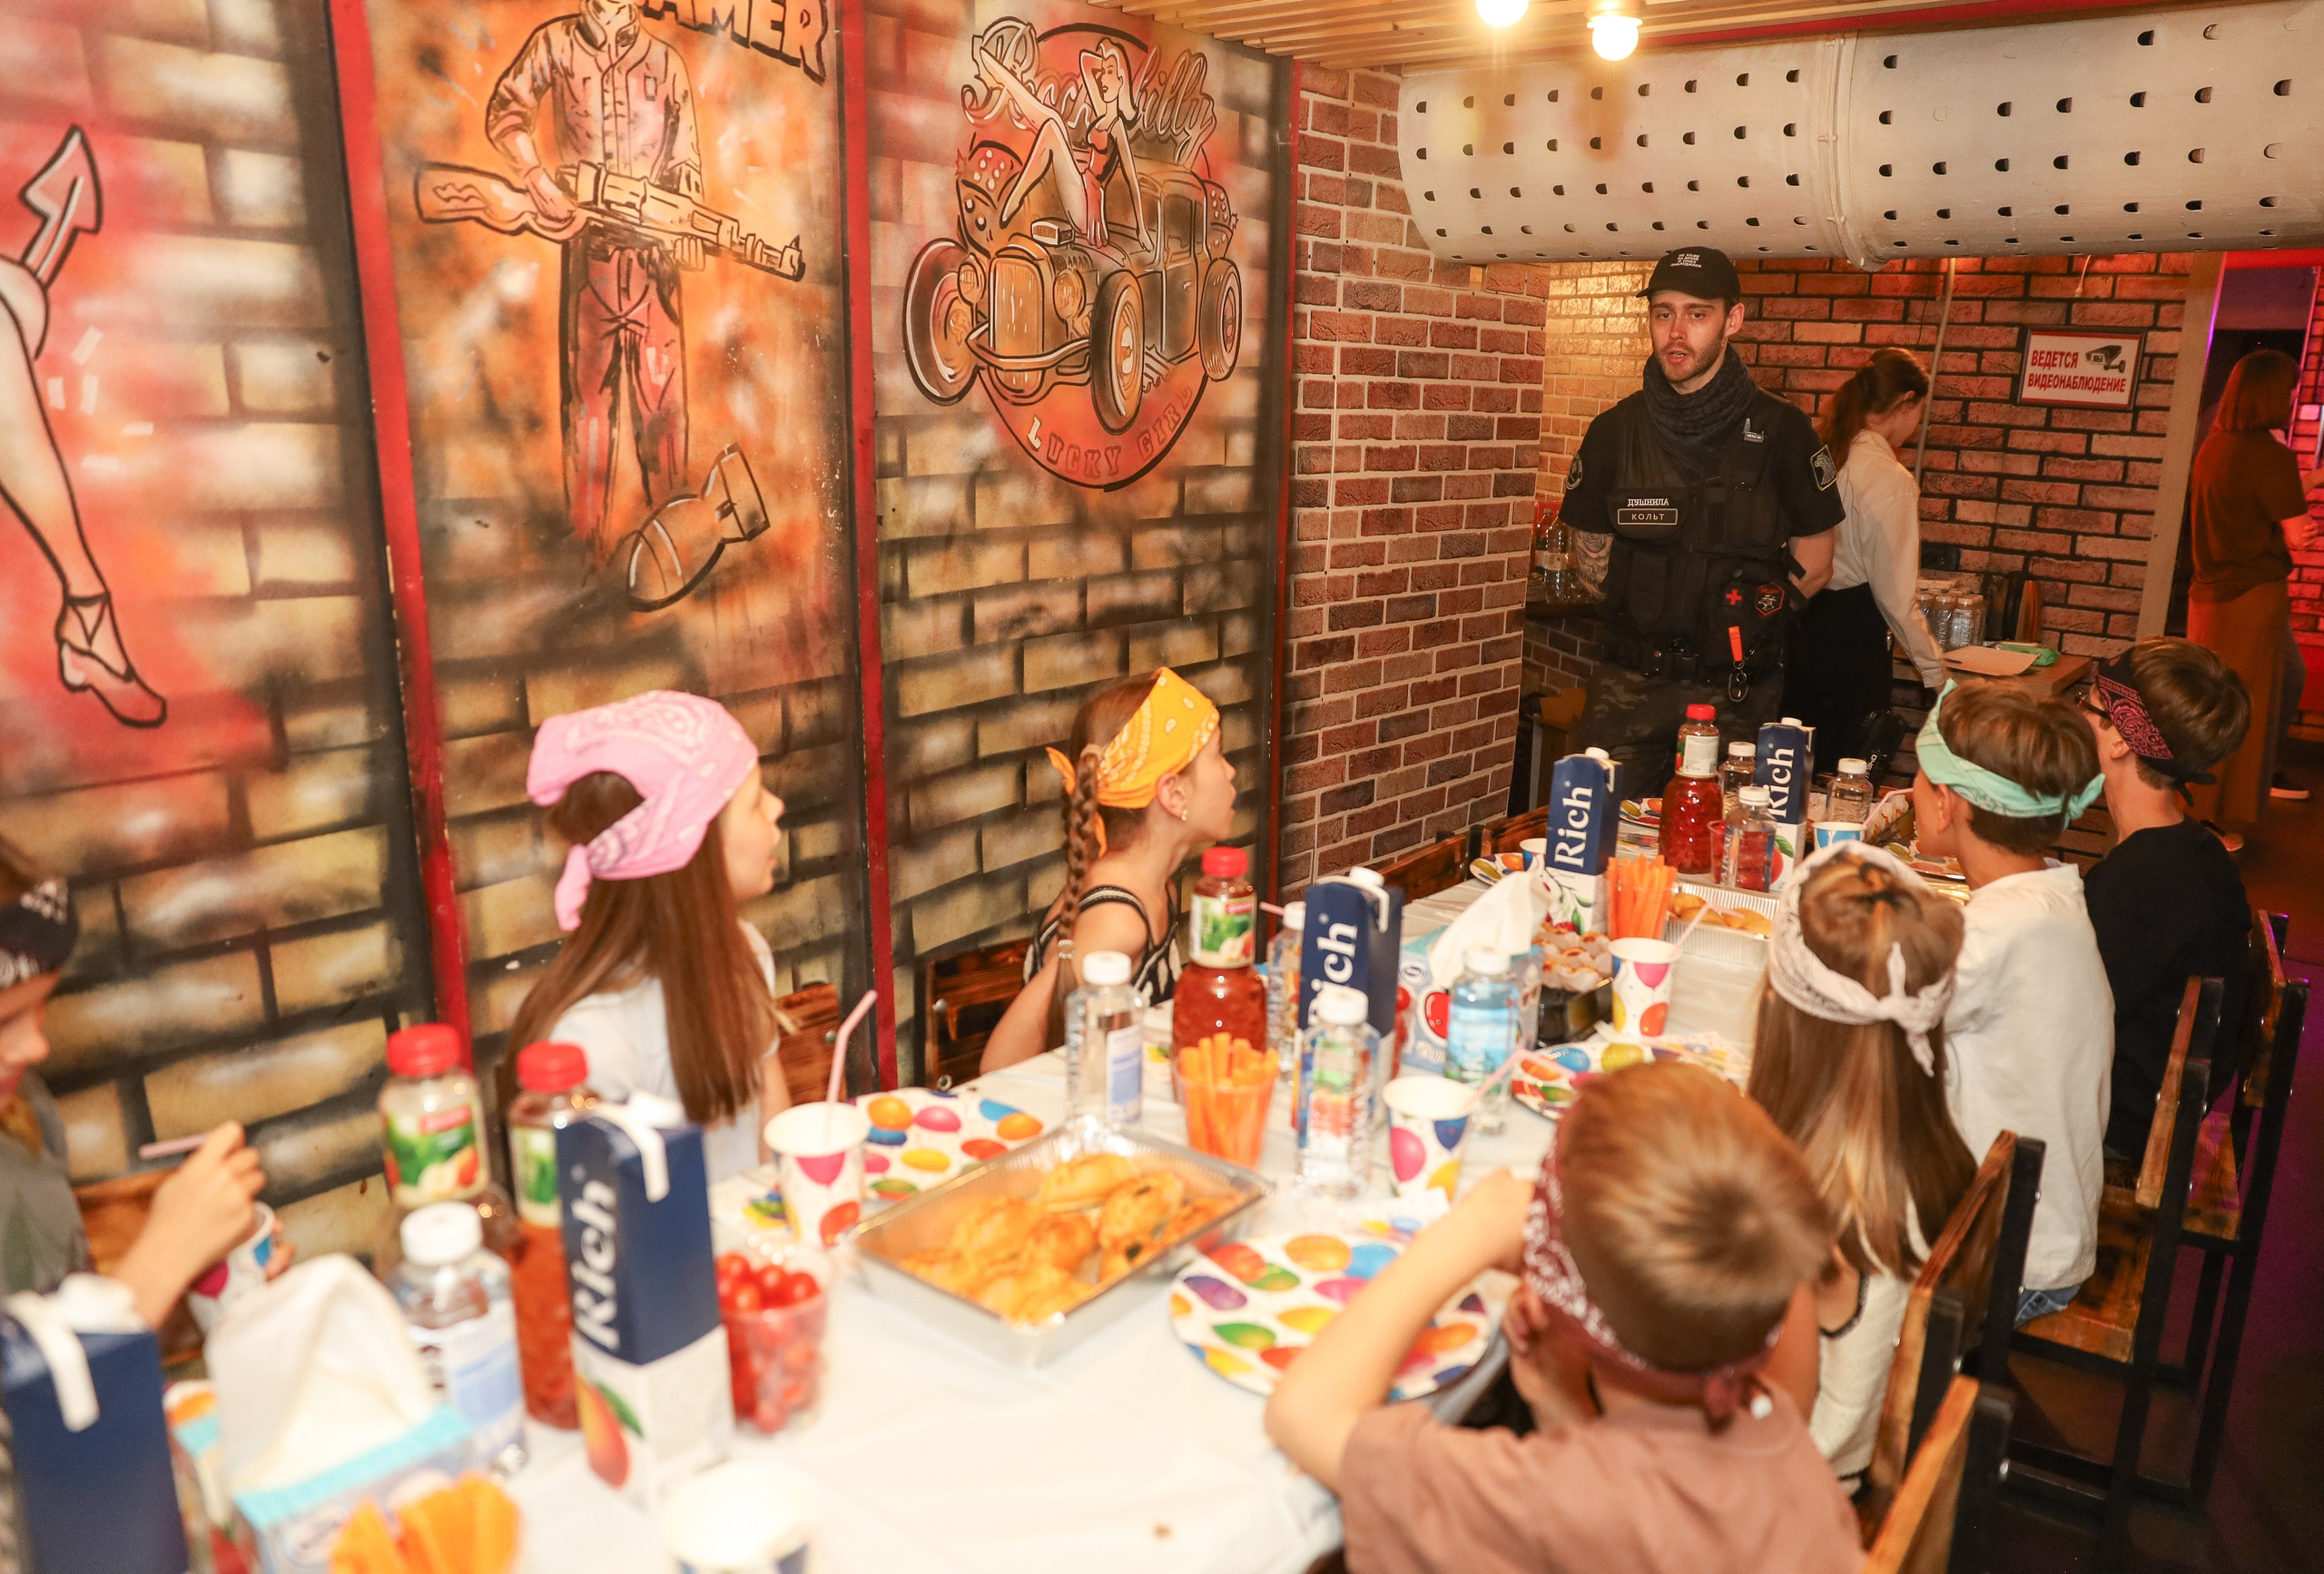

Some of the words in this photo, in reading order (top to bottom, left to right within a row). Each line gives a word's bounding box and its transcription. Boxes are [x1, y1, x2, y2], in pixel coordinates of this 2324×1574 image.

[2027, 373, 2127, 394] ВИДЕОНАБЛЮДЕНИЕ
[2031, 349, 2079, 370] ВЕДЕТСЯ
[1027, 414, 1122, 479] LUCKY
[1137, 386, 1194, 462] GIRL
[1627, 497, 1669, 507] ДУШНИЛА
[1554, 786, 1593, 868] Rich
[1308, 922, 1359, 1026] ich
[572, 1181, 620, 1351] Rich
